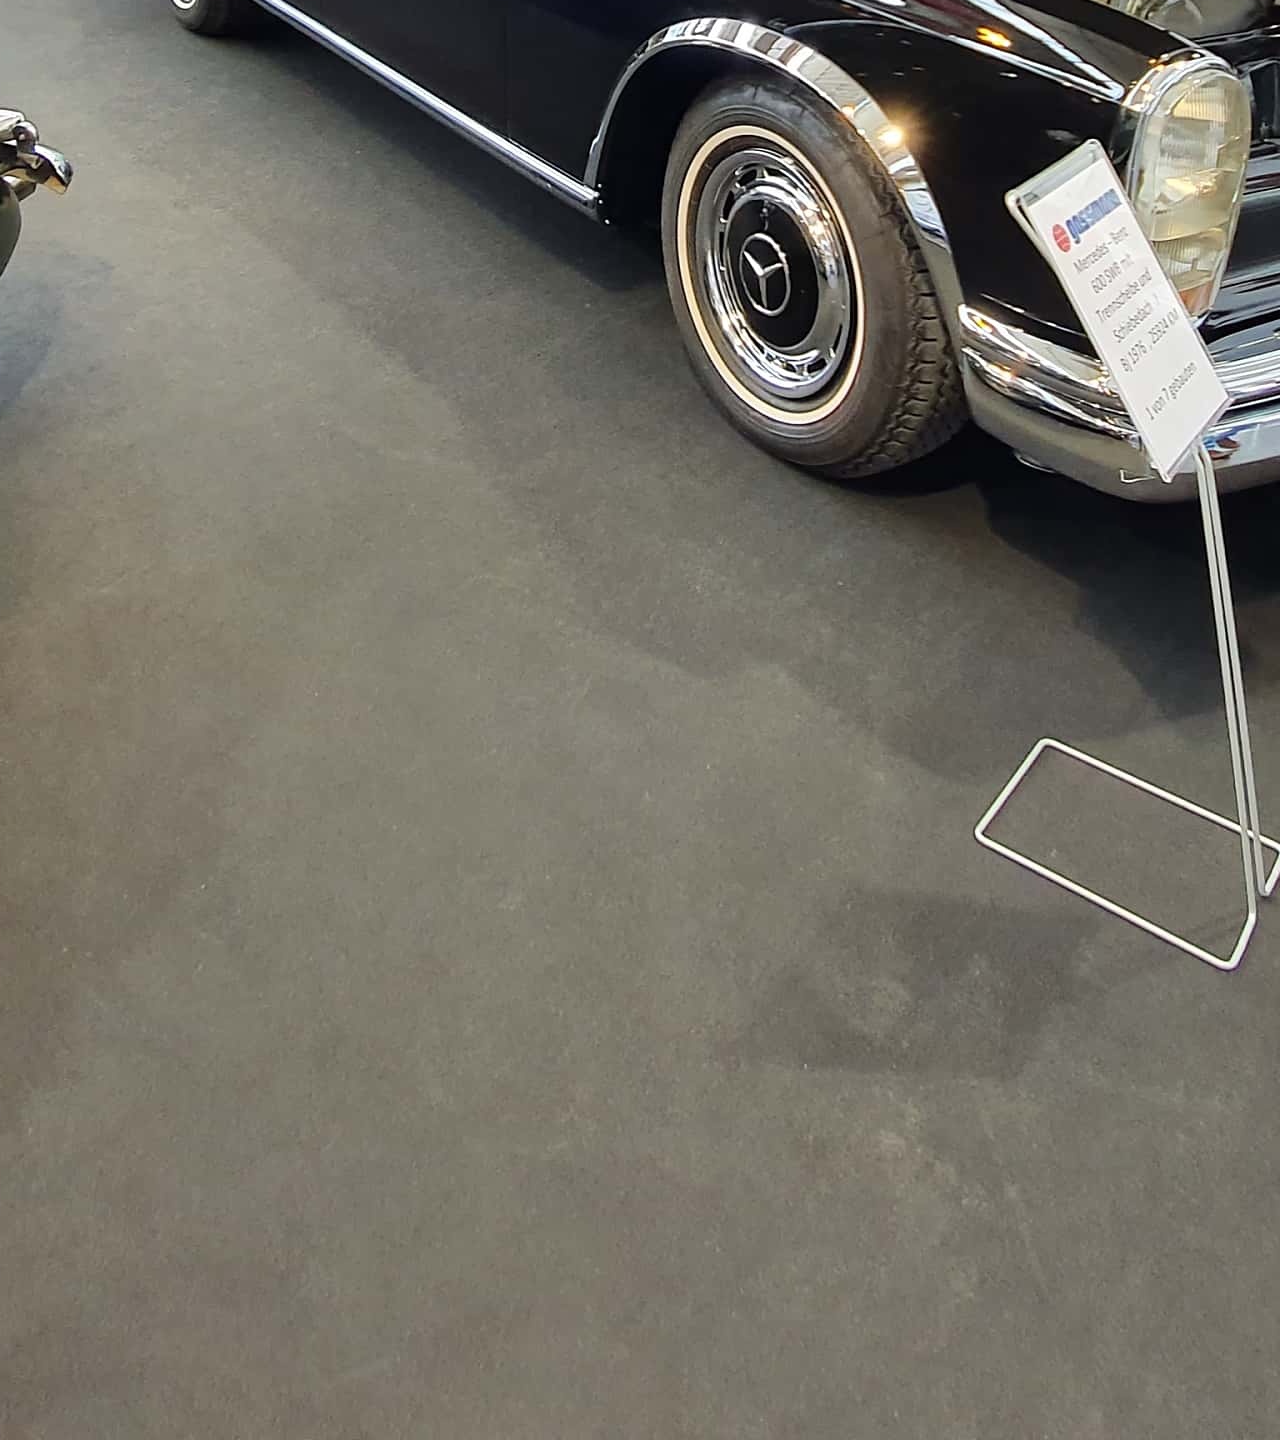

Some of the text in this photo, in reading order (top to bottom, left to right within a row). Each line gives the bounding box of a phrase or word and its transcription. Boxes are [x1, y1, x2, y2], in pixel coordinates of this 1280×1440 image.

[1073, 242, 1110, 274] Mercedes
[1110, 226, 1129, 245] Benz
[1090, 274, 1105, 294] 600
[1095, 266, 1153, 324] Trennscheibe und
[1128, 339, 1148, 365] 1976
[1152, 392, 1167, 415] von
[1168, 361, 1199, 400] gebauten
